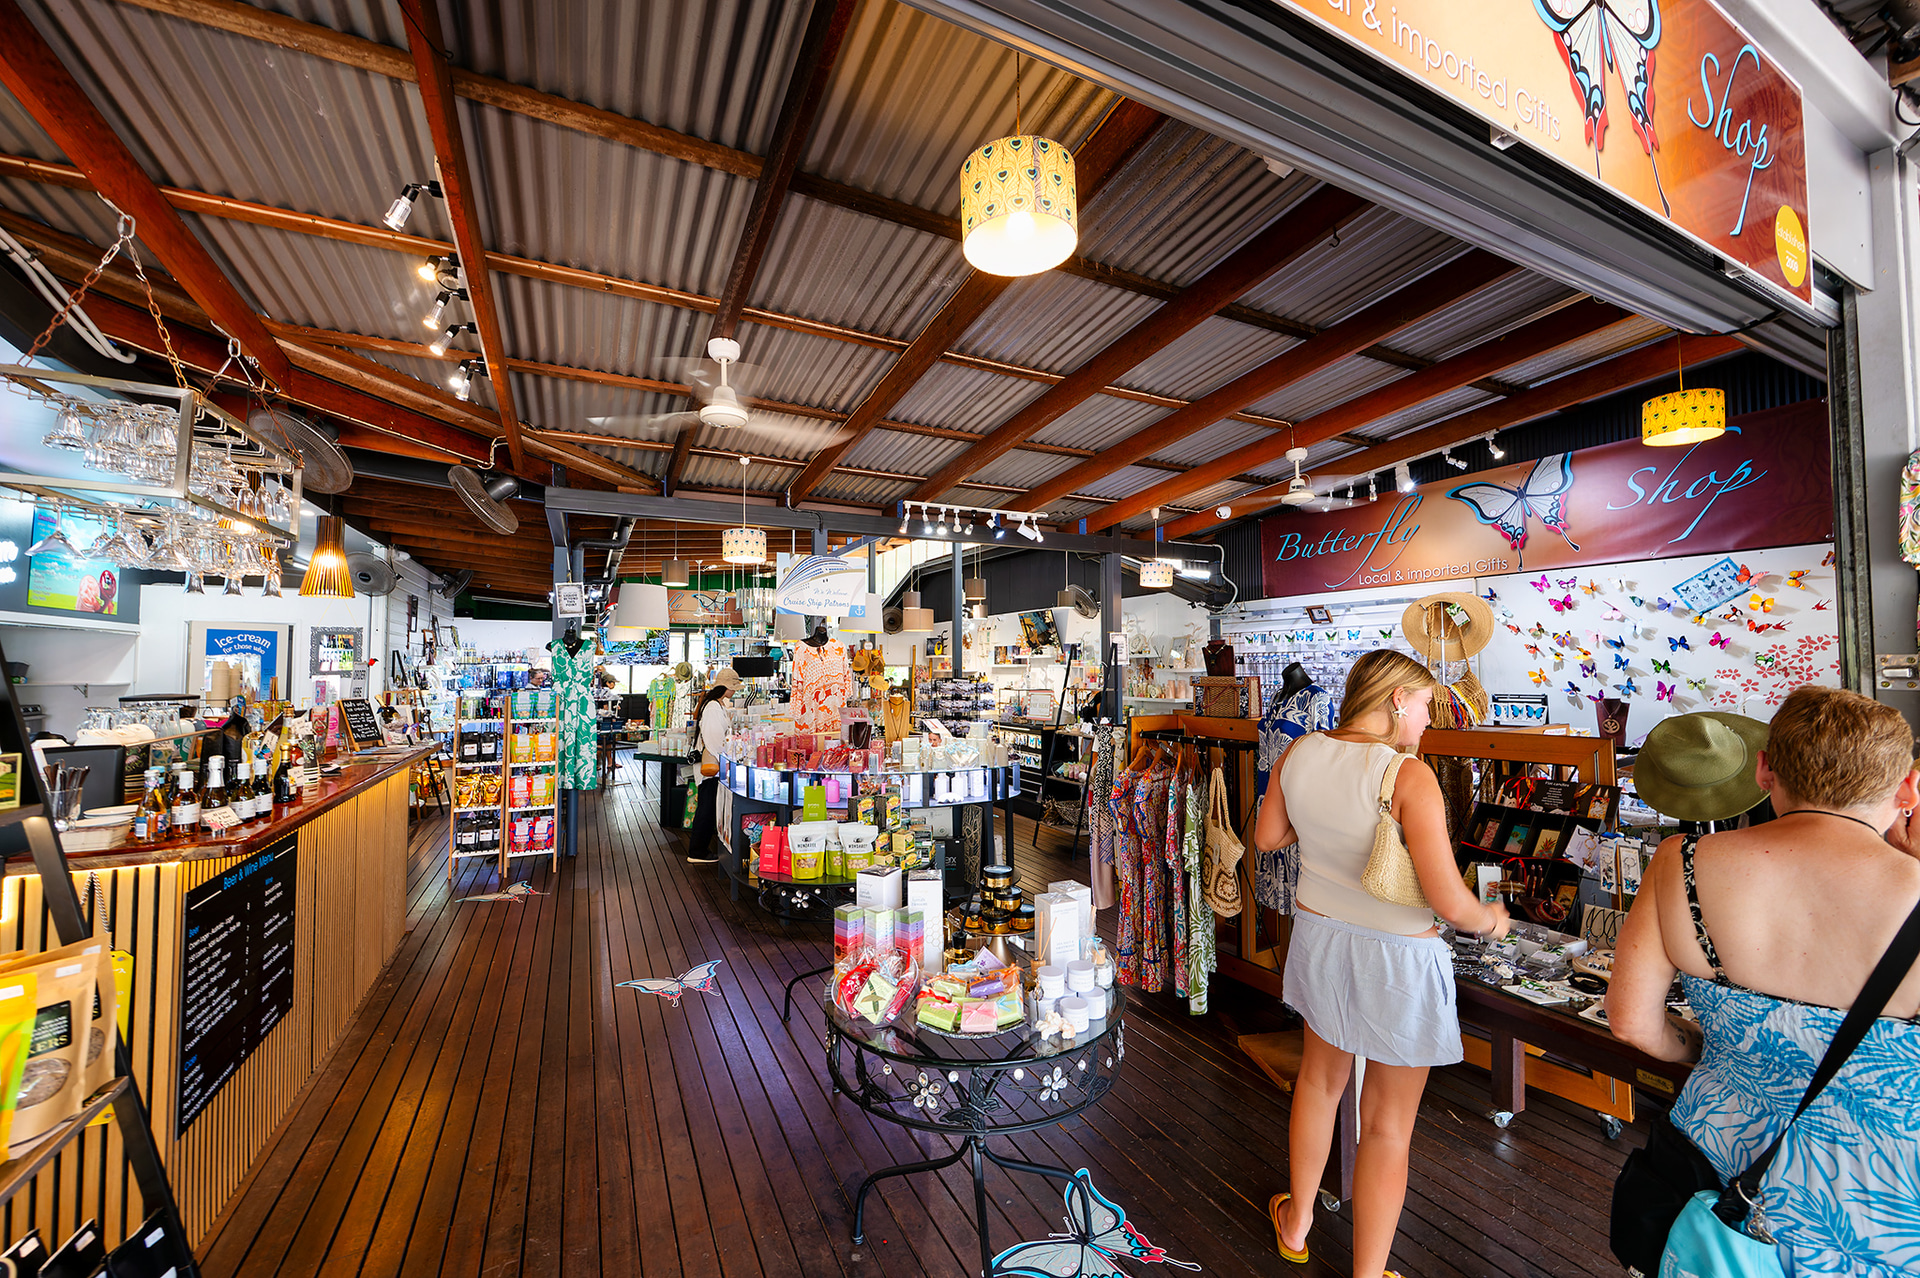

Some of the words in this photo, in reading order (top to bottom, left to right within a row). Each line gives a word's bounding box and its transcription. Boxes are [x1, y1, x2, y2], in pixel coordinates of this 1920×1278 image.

[1392, 6, 1508, 110] imported
[1514, 88, 1560, 142] Gifts
[1688, 44, 1774, 236] Shop
[1776, 222, 1805, 254] Established
[1785, 255, 1798, 273] 2009
[1607, 426, 1768, 544] Shop
[1276, 492, 1424, 588] Butterfly
[1358, 570, 1391, 586] Local
[1395, 570, 1404, 582] &
[1408, 562, 1470, 581] imported
[1474, 558, 1508, 572] Gifts
[783, 596, 806, 606] Cruise
[806, 597, 822, 609] Ship
[824, 598, 849, 608] Patrons
[214, 633, 271, 649] Ice-cream
[222, 645, 233, 655] for
[234, 642, 252, 650] those
[253, 645, 266, 655] who
[223, 877, 238, 890] Beer
[239, 868, 244, 882] &
[244, 860, 258, 876] Wine
[259, 852, 274, 868] Menu
[28, 1034, 68, 1054] ERS
